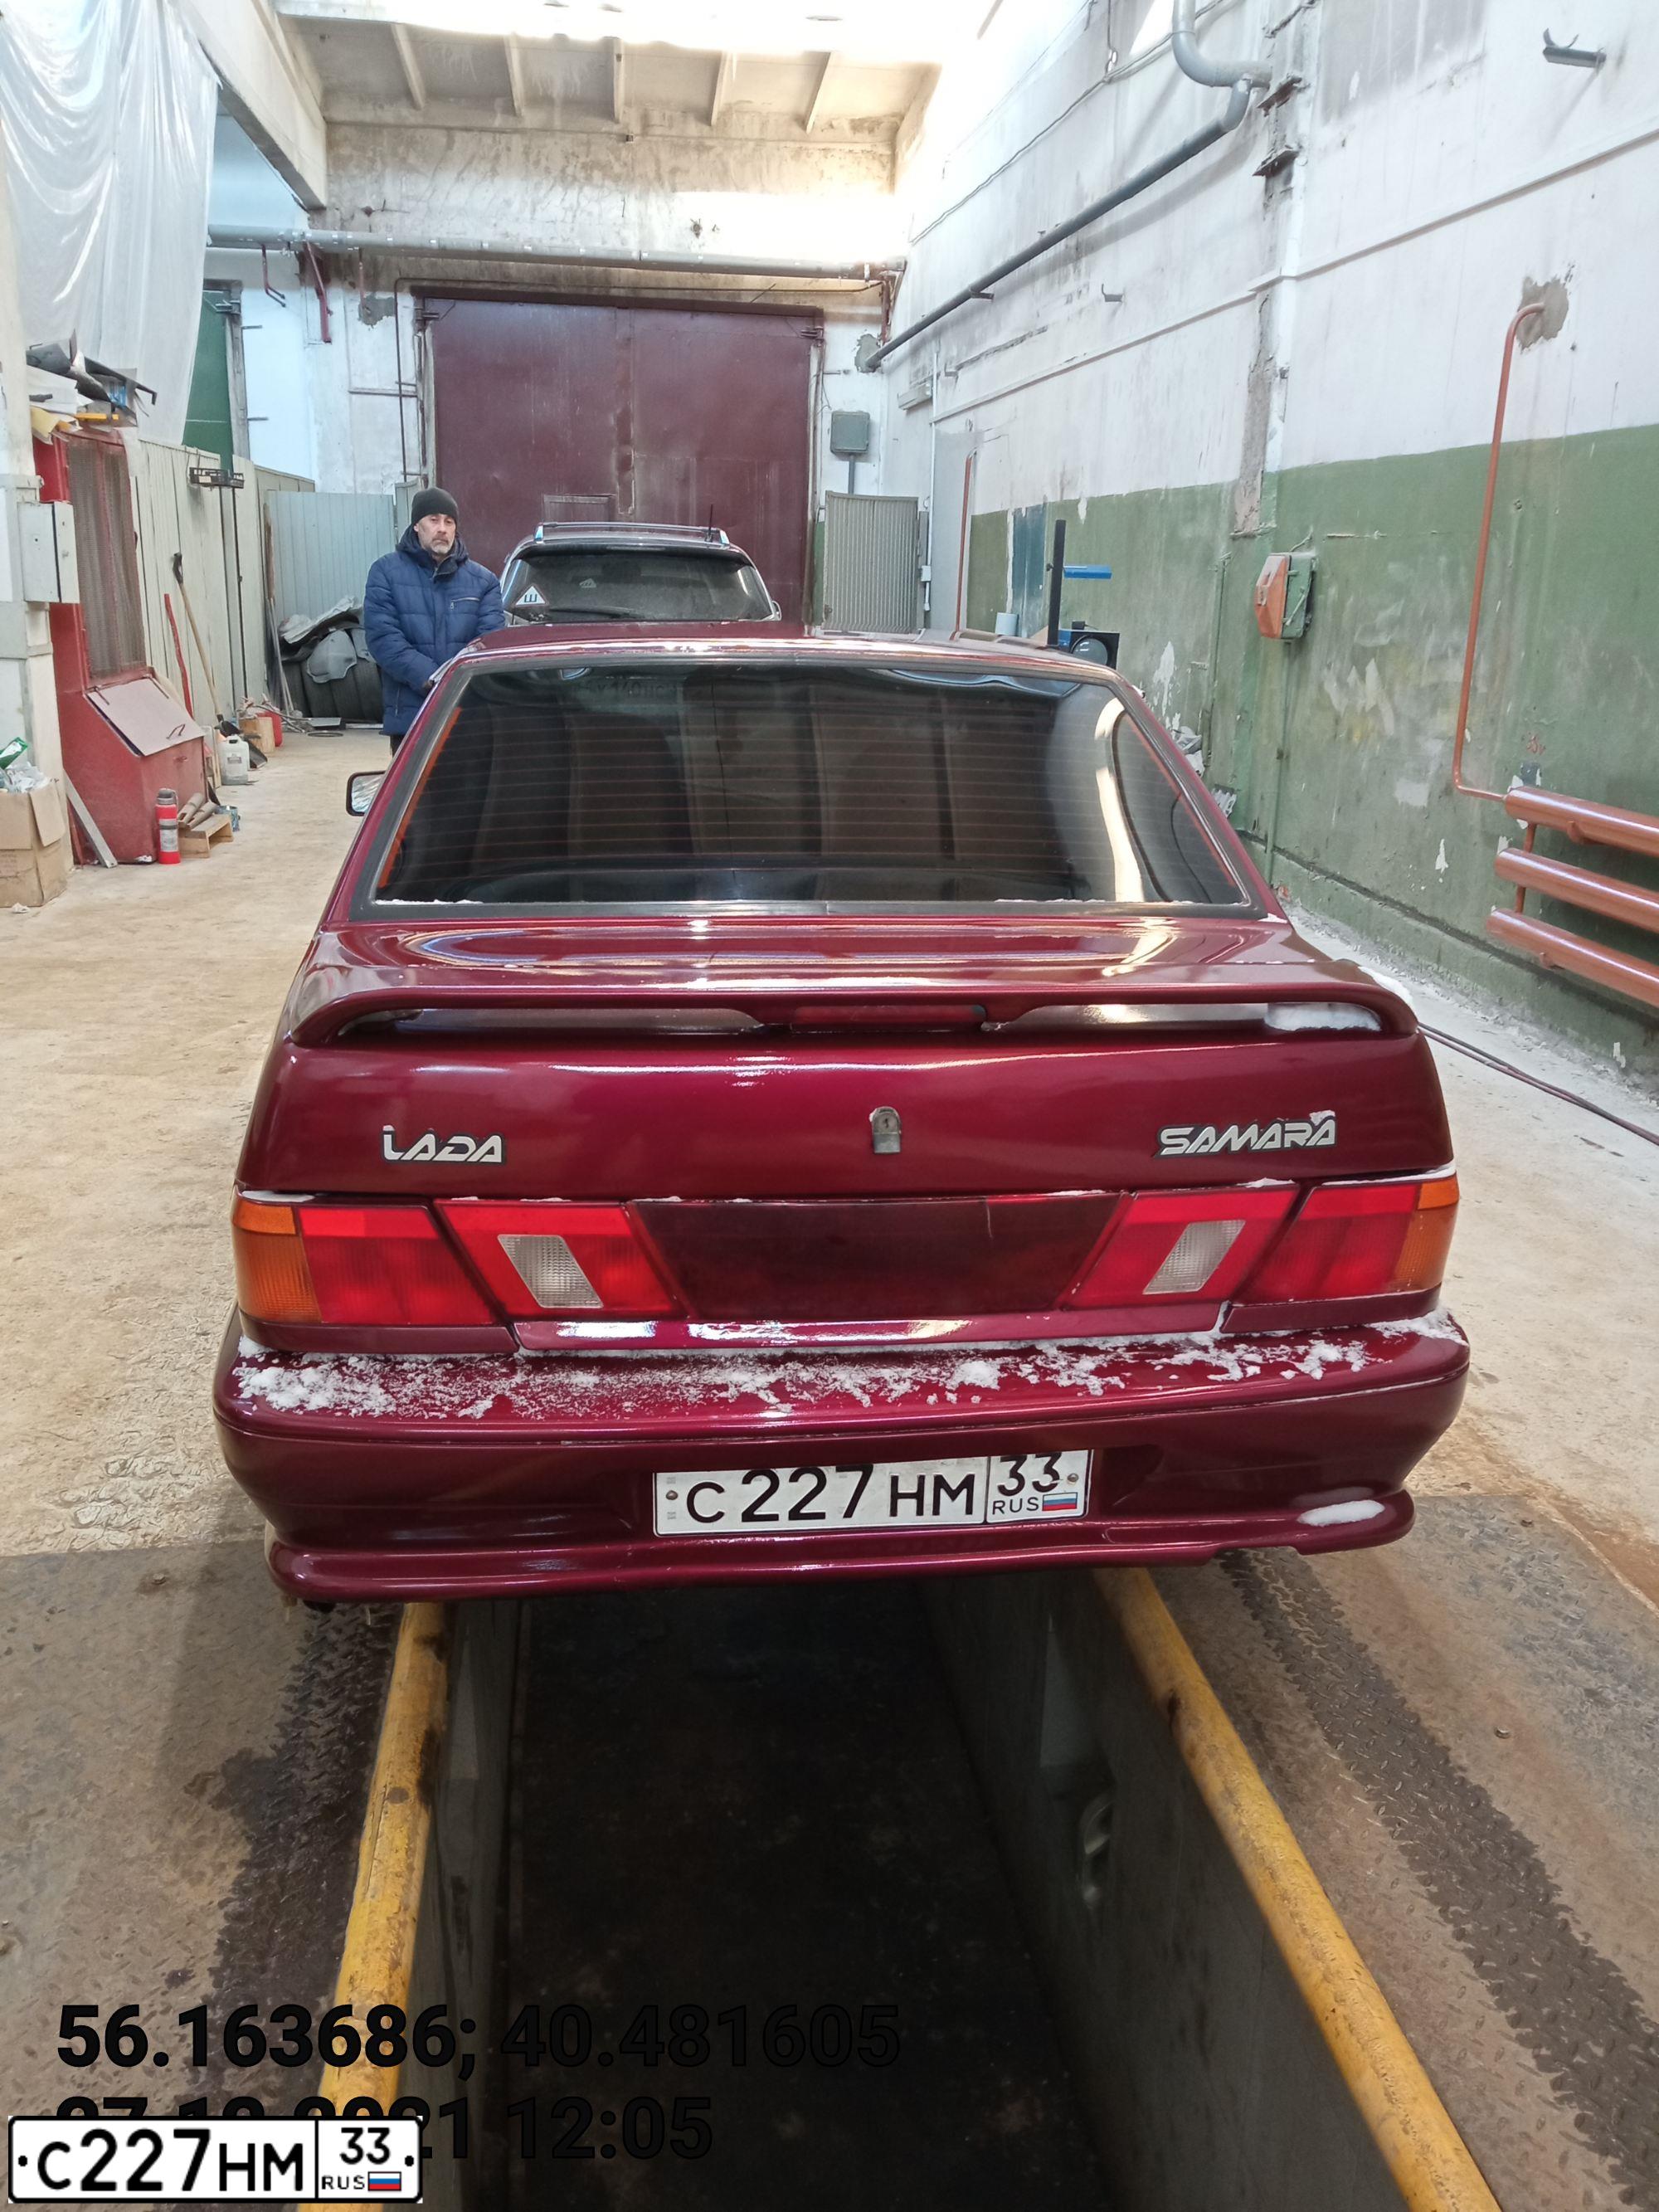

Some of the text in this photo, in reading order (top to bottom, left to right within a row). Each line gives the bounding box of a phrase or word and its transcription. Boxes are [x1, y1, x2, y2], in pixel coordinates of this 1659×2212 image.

[524, 593, 538, 603] Ш
[382, 1133, 503, 1163] LADA
[1160, 1120, 1336, 1157] SAMARA
[996, 1452, 1062, 1497] 33
[992, 1496, 1039, 1515] RUS
